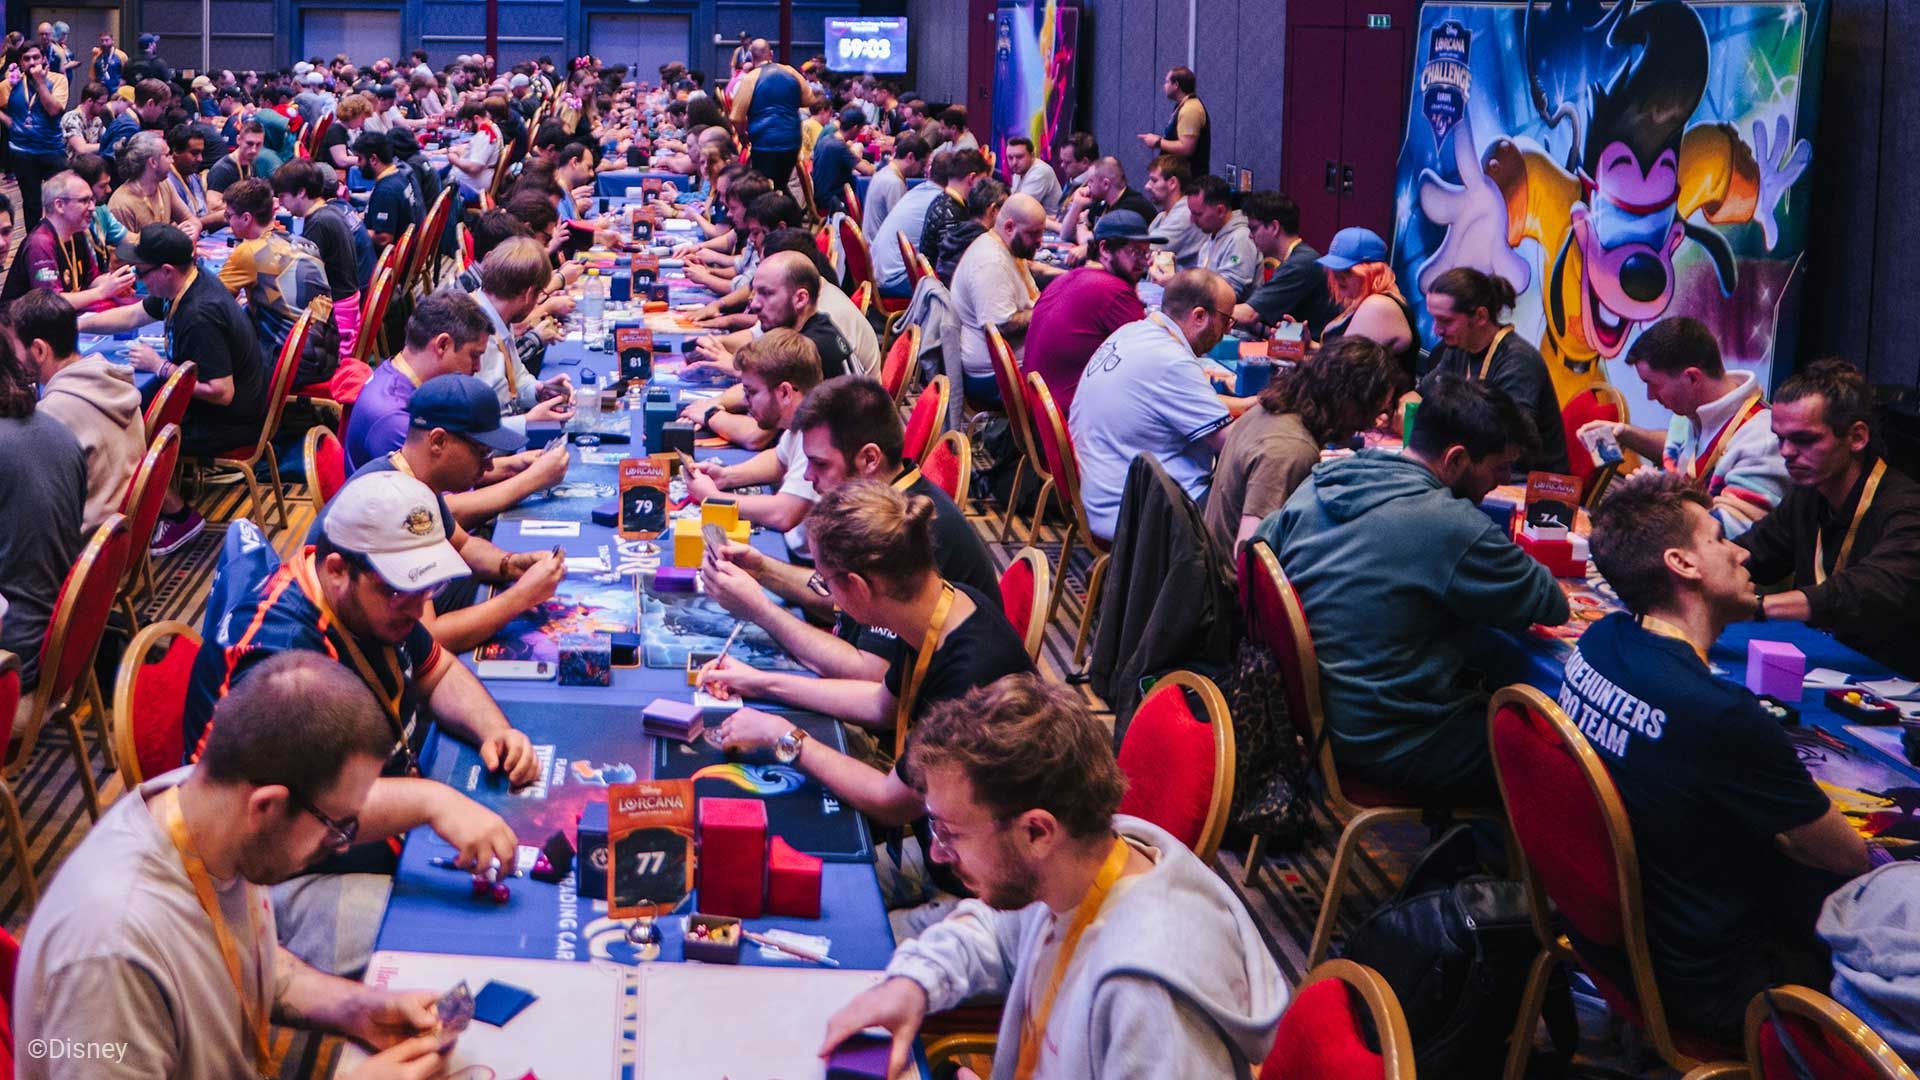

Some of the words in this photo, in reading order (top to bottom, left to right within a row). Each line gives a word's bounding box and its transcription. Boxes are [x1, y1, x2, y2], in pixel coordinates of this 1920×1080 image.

[1421, 61, 1472, 103] CHALLENGE
[630, 357, 642, 368] 81
[635, 500, 653, 514] 79
[1578, 703, 1630, 756] TEAM
[618, 795, 684, 812] LORCANA
[637, 850, 666, 875] 77
